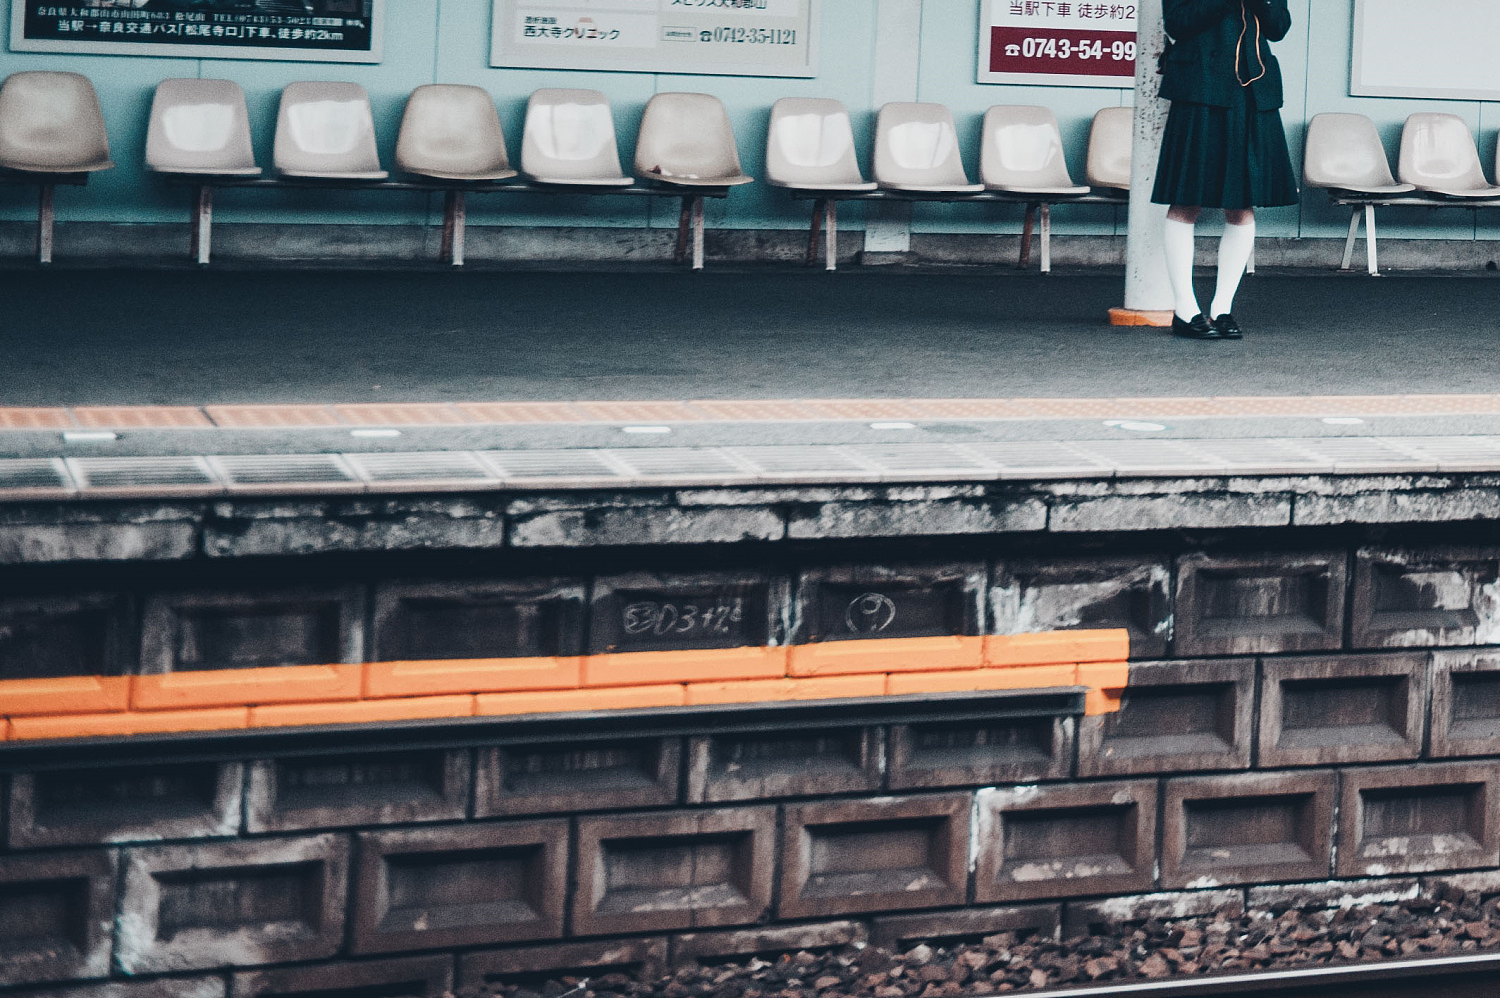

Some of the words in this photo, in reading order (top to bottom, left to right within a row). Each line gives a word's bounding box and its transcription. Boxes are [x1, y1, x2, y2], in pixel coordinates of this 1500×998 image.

[1009, 0, 1072, 17] 当駅下車
[524, 25, 620, 40] 西大寺クリニック
[713, 26, 797, 44] 0742-35-1121
